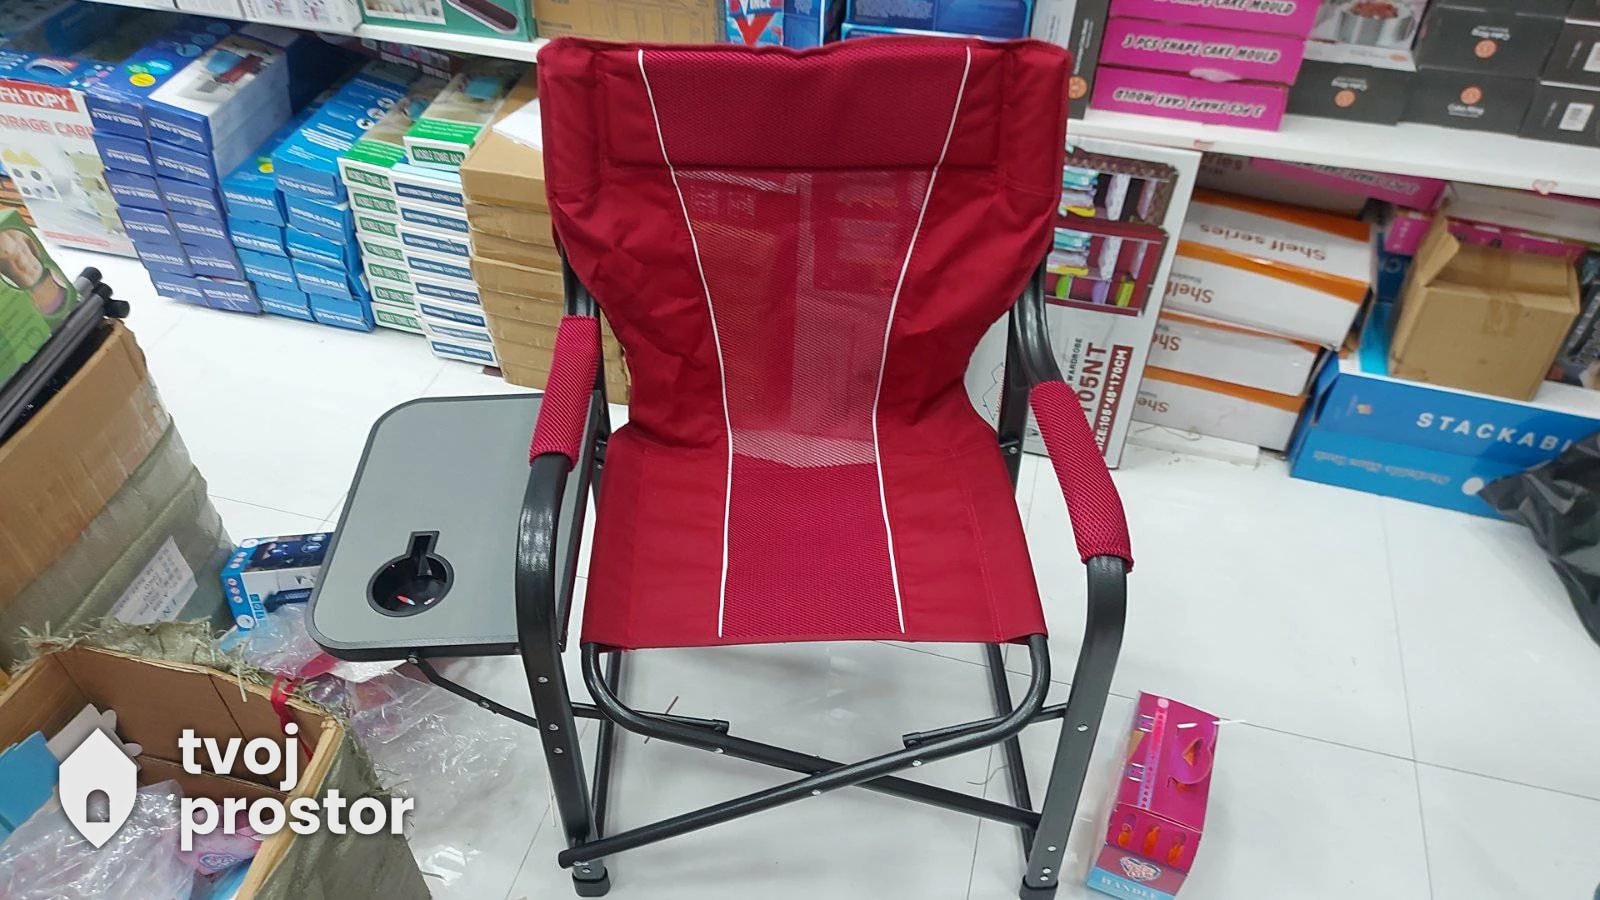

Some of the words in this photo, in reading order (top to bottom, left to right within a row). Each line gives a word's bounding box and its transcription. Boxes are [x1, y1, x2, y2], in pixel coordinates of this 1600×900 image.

[1135, 36, 1160, 51] PCS
[1161, 38, 1200, 55] SHAPE
[1201, 43, 1233, 58] CAKE
[1234, 46, 1281, 64] MOULD
[1113, 88, 1156, 105] MOULD
[1156, 93, 1186, 109] CAKE
[1200, 224, 1265, 245] series
[1270, 240, 1326, 261] Shelf
[1067, 337, 1083, 381] WARDROBE
